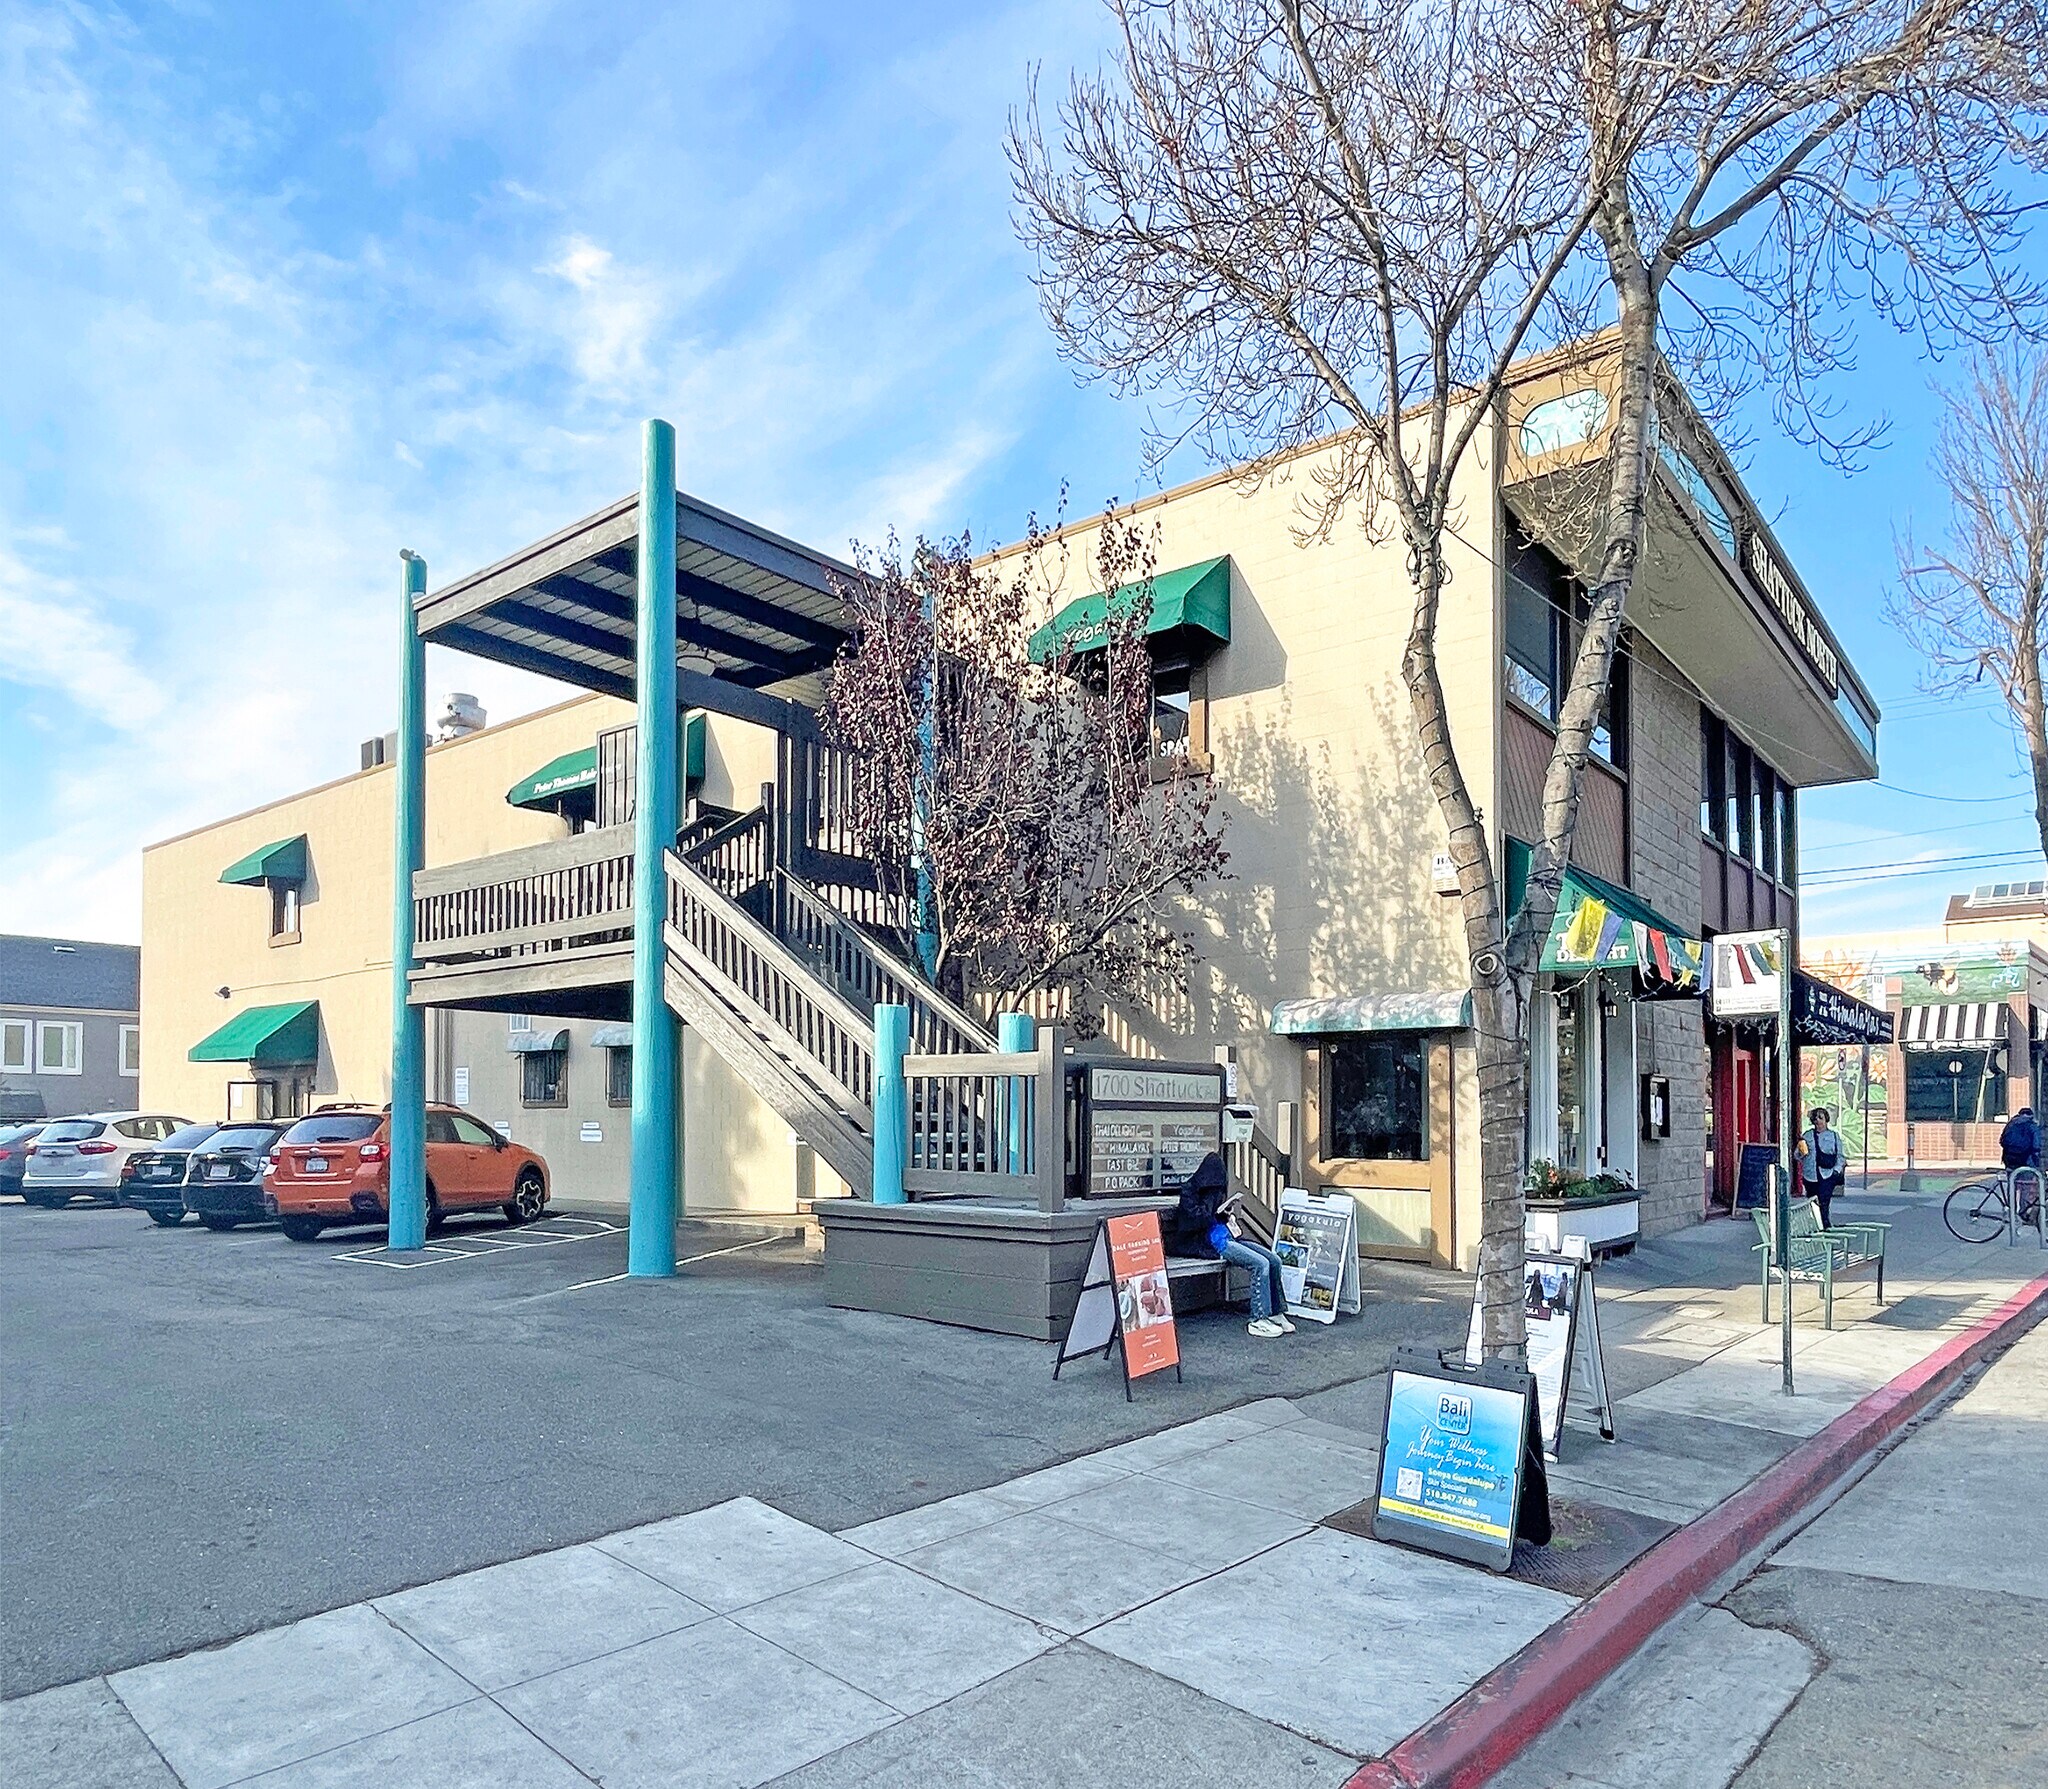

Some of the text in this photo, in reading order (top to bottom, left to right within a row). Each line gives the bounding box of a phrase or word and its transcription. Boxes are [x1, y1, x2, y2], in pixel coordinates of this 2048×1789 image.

[1752, 531, 1837, 690] SHATTUCK NORTH
[533, 782, 554, 794] Peter
[1096, 1074, 1130, 1097] 1700
[1134, 1075, 1203, 1099] Shattuck
[1095, 1124, 1110, 1137] THAI
[1107, 1159, 1125, 1171] FAST
[1289, 1213, 1341, 1228] yogakula
[1441, 1397, 1467, 1416] Bali
[1420, 1424, 1488, 1456] Your Wellness
[1406, 1441, 1496, 1472] Journey Begin here
[1452, 1473, 1496, 1490] Guadalupe
